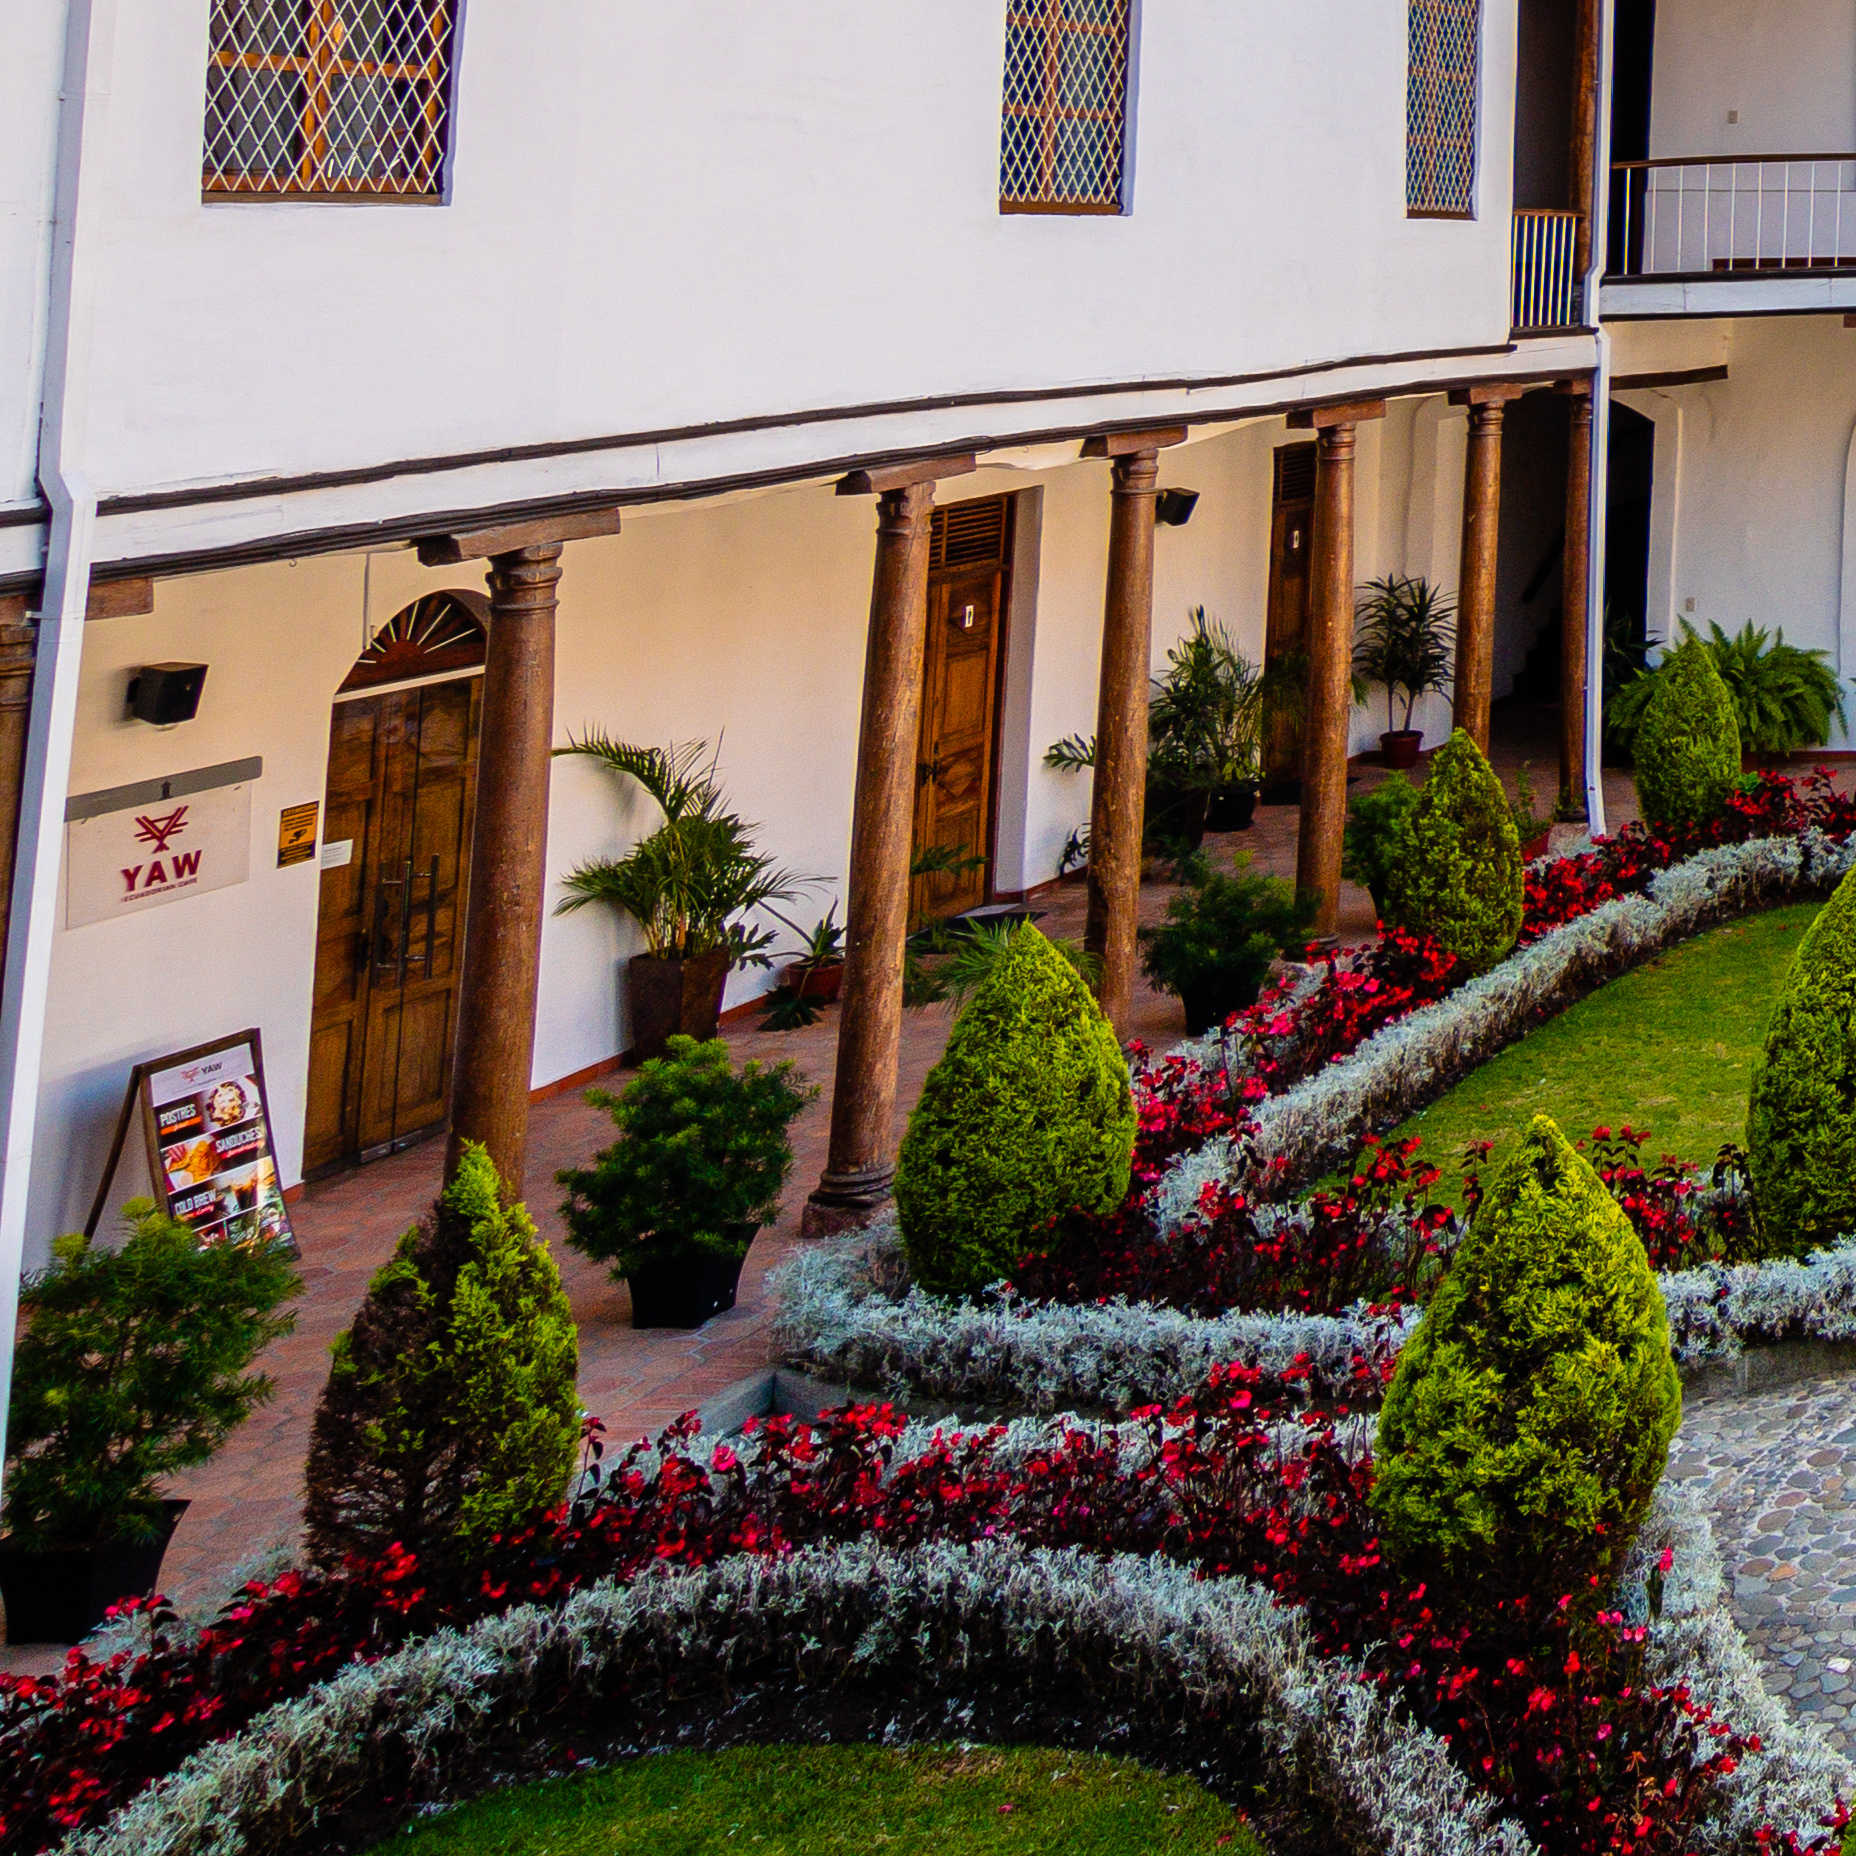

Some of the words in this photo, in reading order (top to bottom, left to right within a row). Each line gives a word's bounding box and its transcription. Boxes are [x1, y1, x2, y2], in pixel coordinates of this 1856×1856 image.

[121, 850, 202, 892] YAW
[201, 1061, 223, 1075] YAW
[159, 1103, 197, 1127] POSTRES
[174, 1197, 193, 1215] COLD
[194, 1189, 217, 1209] BREW
